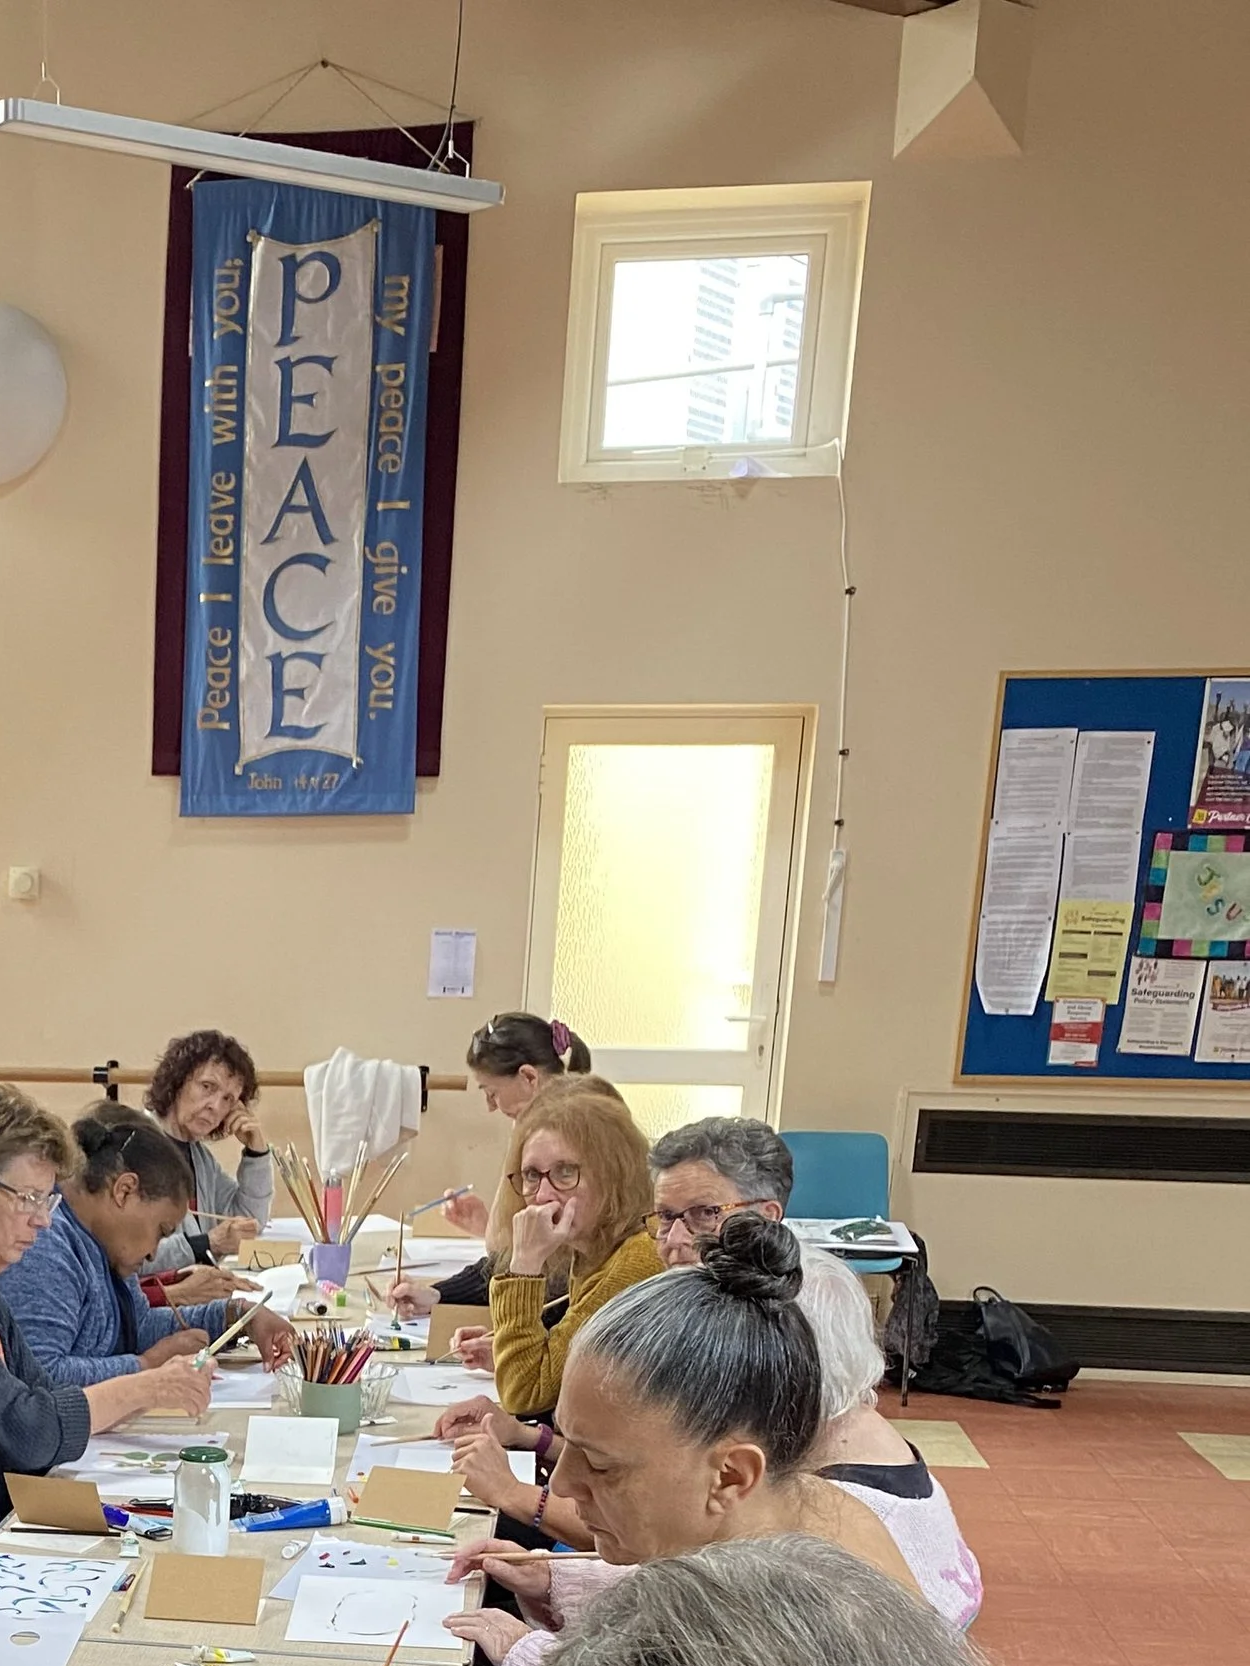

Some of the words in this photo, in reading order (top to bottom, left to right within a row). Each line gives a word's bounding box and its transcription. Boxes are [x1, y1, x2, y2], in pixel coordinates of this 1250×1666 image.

[375, 274, 411, 337] my
[204, 365, 239, 446] with
[376, 362, 407, 474] peace
[202, 470, 236, 566] leave
[259, 250, 342, 741] PEACE
[376, 500, 411, 511] I
[199, 592, 233, 603] I
[364, 540, 408, 616] give
[197, 626, 232, 731] Peace
[365, 642, 396, 720] you.
[248, 772, 282, 790] John
[1131, 987, 1196, 1001] Safeguarding
